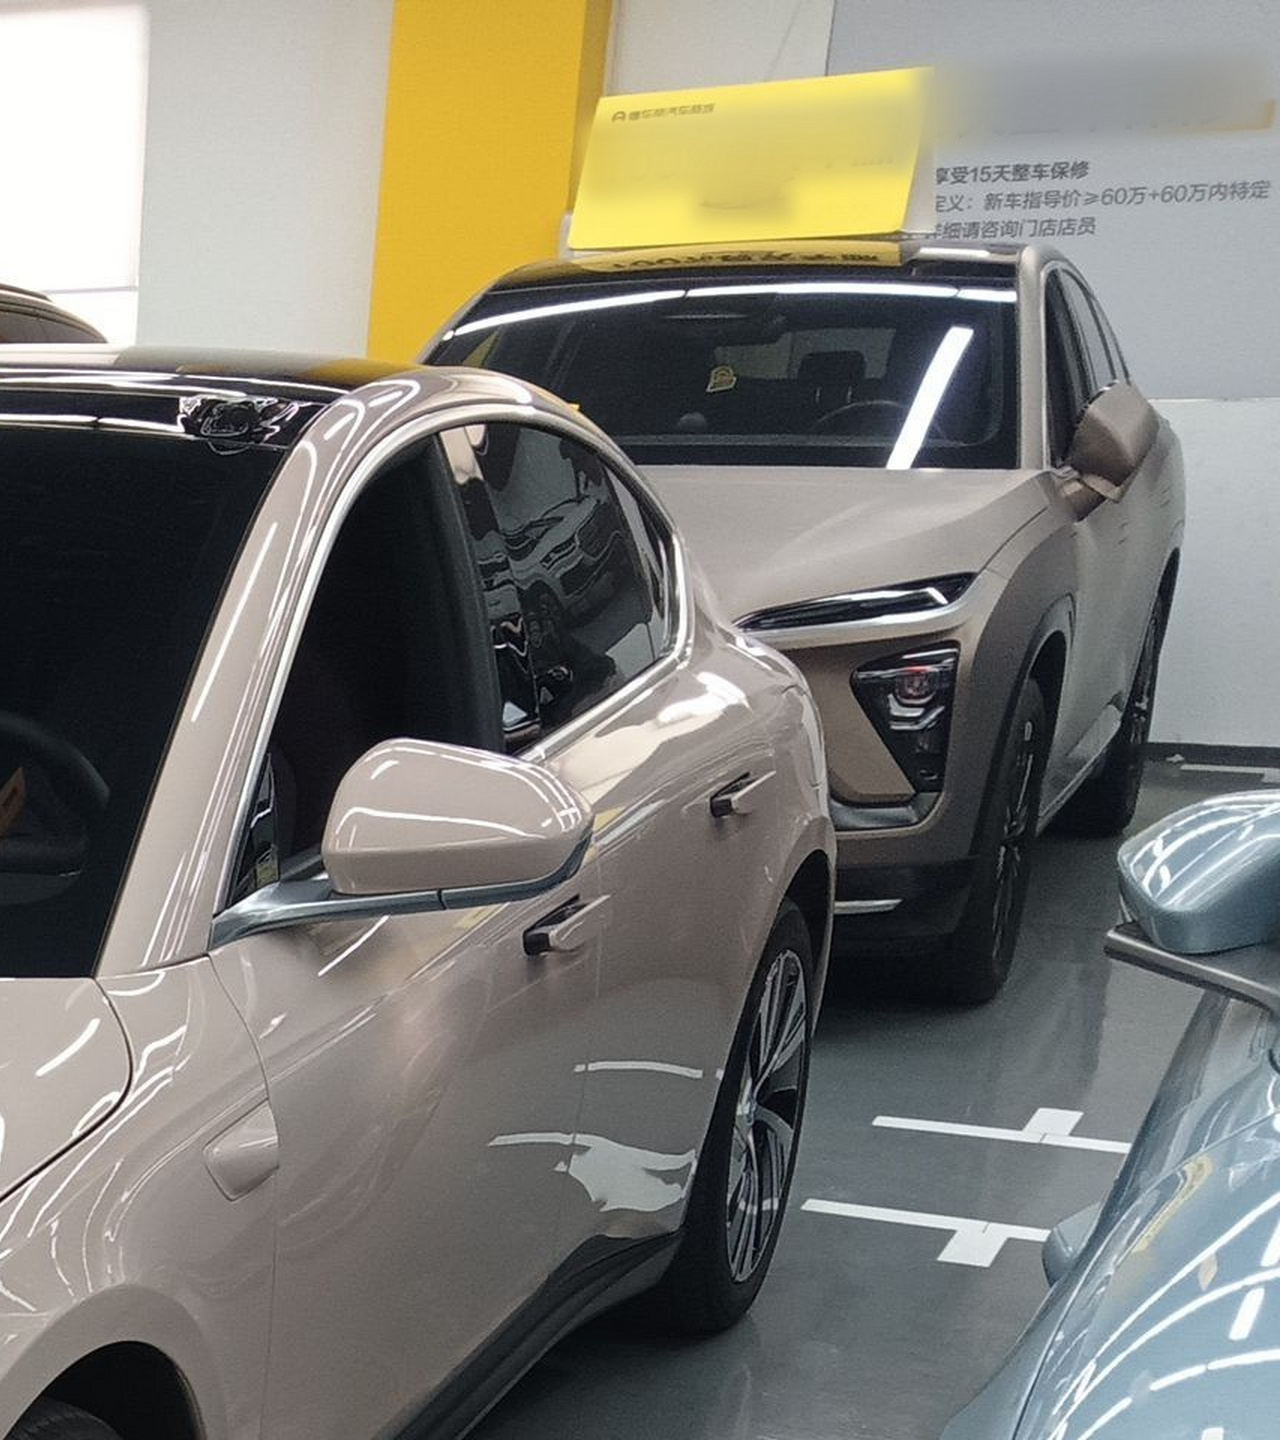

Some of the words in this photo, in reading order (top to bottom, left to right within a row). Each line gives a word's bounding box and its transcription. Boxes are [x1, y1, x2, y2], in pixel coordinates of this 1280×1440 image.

[936, 160, 1089, 185] 享受15天整车保修
